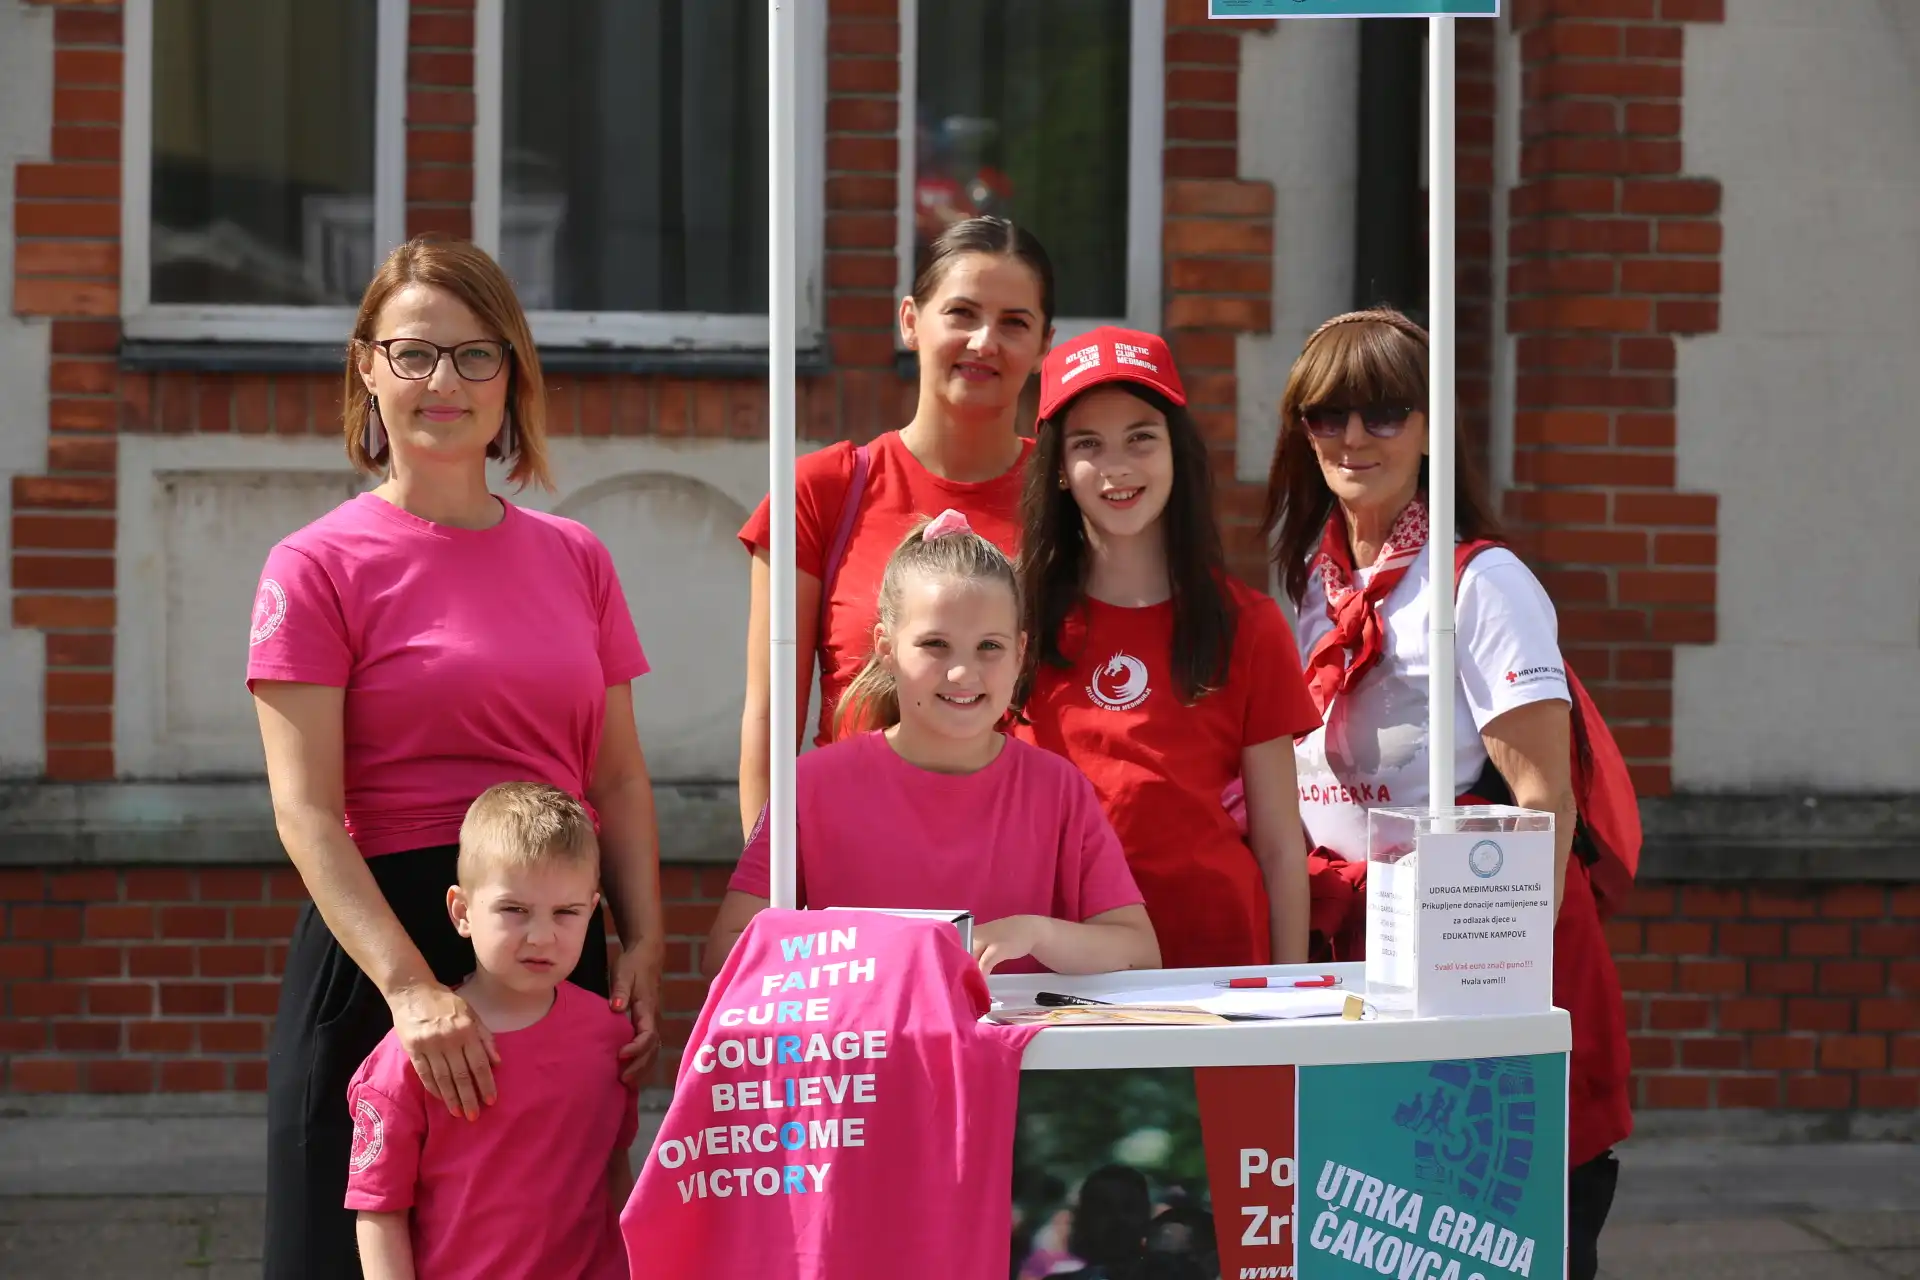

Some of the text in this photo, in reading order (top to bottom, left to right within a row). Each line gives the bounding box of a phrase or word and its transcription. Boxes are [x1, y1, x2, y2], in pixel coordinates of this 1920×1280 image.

[1065, 344, 1099, 365] ATLETSKI
[1079, 351, 1100, 364] KLUB
[1114, 342, 1149, 356] ATHLETIC
[1115, 349, 1136, 359] CLUB
[1518, 666, 1550, 677] HRVATSKI
[1084, 685, 1105, 708] ATLETSKI
[1298, 782, 1391, 806] LONTERKA
[1429, 886, 1461, 894] UDRUGA
[1462, 884, 1510, 893] MEĐIMURSKI
[1421, 901, 1462, 911] Prikupljene
[1463, 900, 1493, 910] donacije
[1494, 899, 1538, 909] namijenjene
[1462, 916, 1490, 924] odlazak
[1491, 915, 1510, 925] djece
[781, 927, 857, 962] WIN
[1442, 930, 1527, 940] EDUKATIVNE KAMPOVE
[1455, 962, 1468, 970] Vaš
[1486, 960, 1505, 970] znači
[1506, 960, 1533, 969] puno!!!
[761, 957, 876, 997] FAITH
[1461, 976, 1506, 986] Hvala vam!!!
[719, 997, 831, 1027] CURE
[693, 1030, 887, 1074] COURAGE
[712, 1073, 876, 1112] BELIEVE
[657, 1118, 865, 1169] OVERCOME
[1240, 1147, 1294, 1189] Po
[677, 1163, 831, 1204] VICTORY
[1315, 1159, 1536, 1278] UTRKA GRADA
[1309, 1205, 1463, 1280] ČAKOVCA
